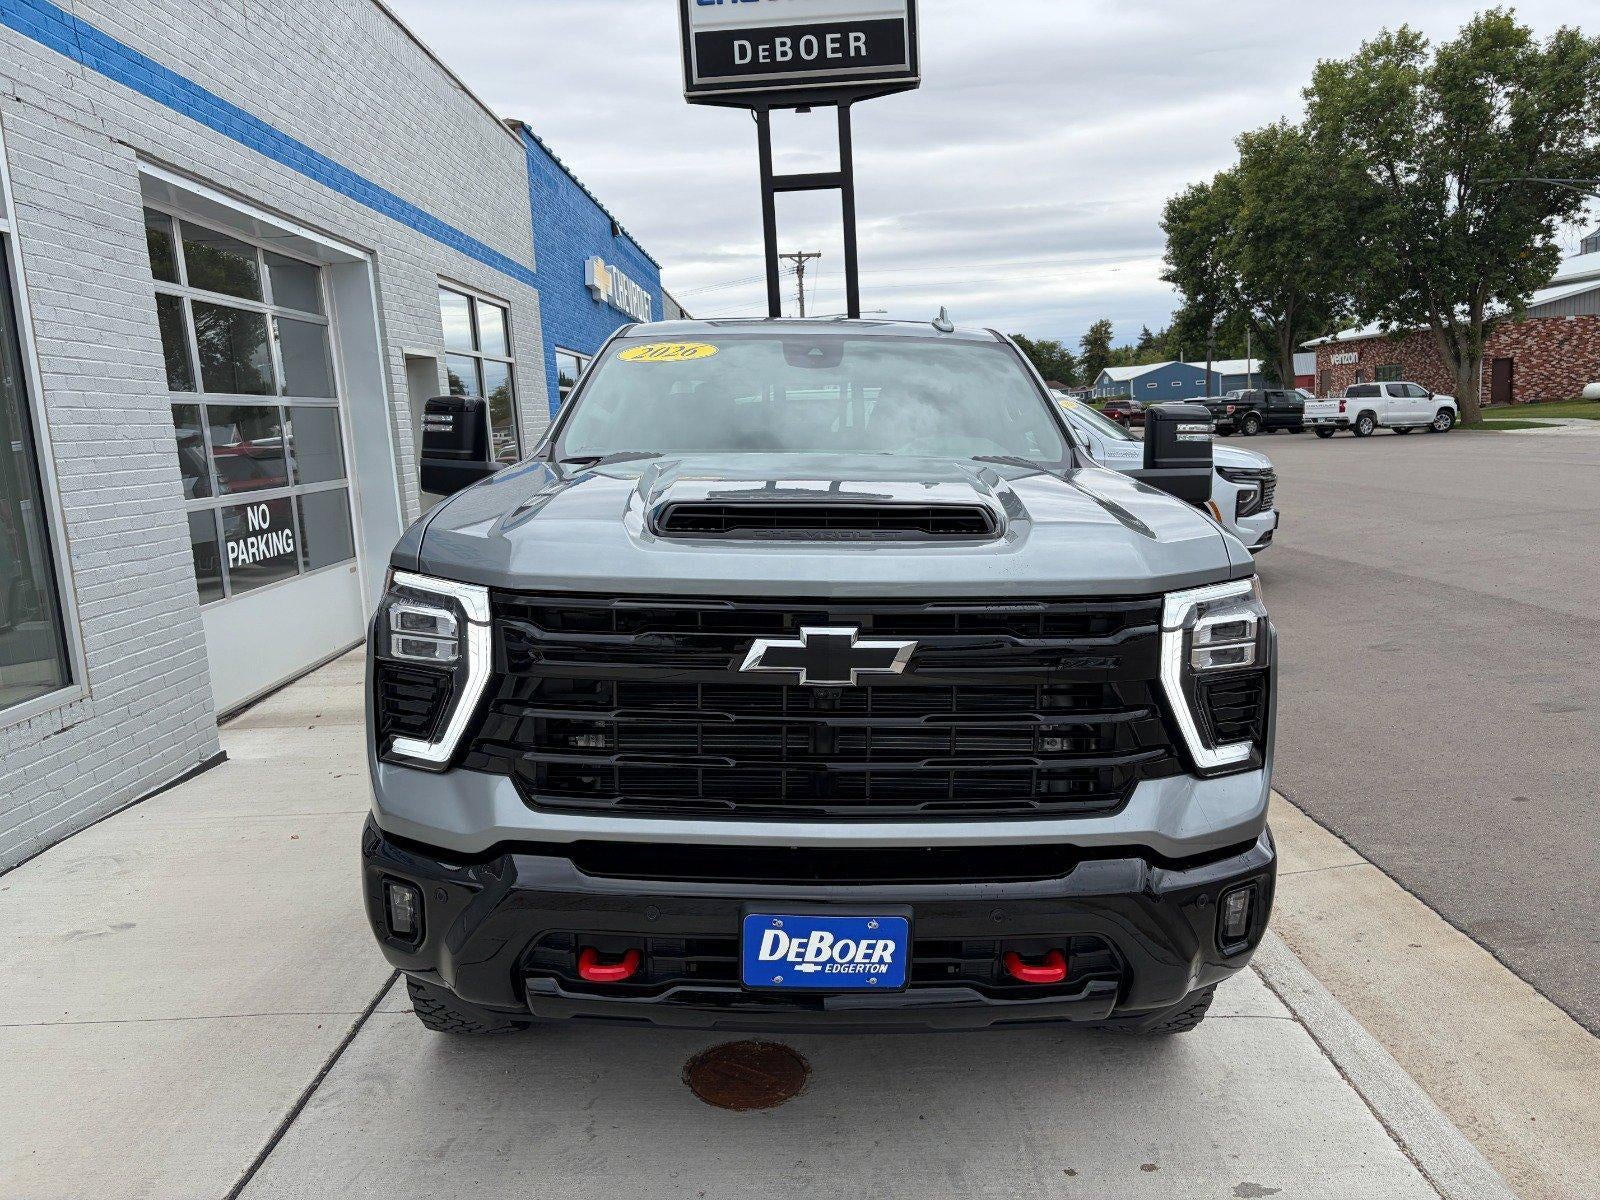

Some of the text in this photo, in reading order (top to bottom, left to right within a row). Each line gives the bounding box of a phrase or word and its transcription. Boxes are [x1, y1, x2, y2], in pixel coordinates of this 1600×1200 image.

[631, 345, 700, 359] 2026
[1330, 351, 1359, 365] verizon
[246, 503, 270, 532] NO
[752, 529, 903, 541] CHEVROLET
[226, 528, 294, 568] PARKING
[824, 963, 888, 974] EDGERTON
